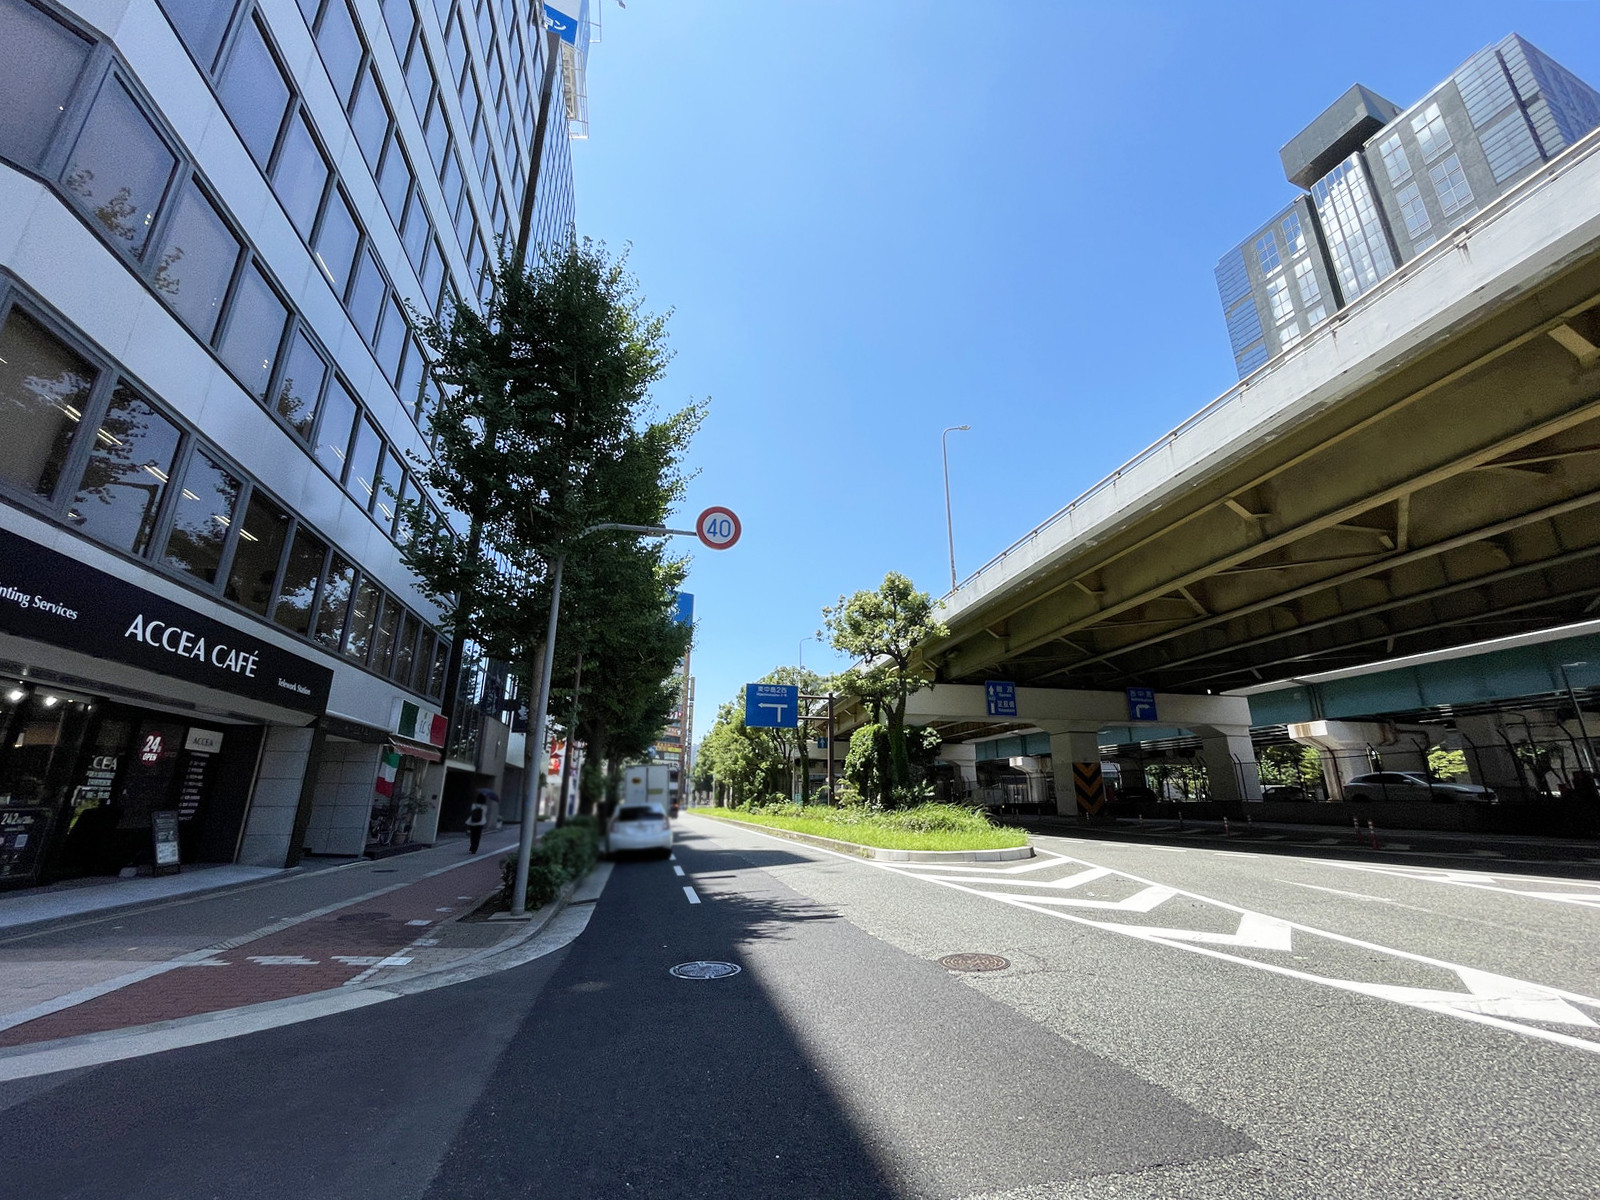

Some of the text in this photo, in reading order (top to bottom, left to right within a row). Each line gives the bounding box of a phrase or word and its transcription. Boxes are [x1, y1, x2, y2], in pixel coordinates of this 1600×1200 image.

[543, 15, 567, 31] ョン
[706, 518, 731, 538] 40
[0, 580, 79, 620] nting Services
[125, 614, 259, 678] ACCEA CAFÉ
[296, 684, 312, 696] Station
[192, 737, 214, 747] ACCEA
[88, 755, 118, 771] CEA
[142, 752, 158, 761] OPEN
